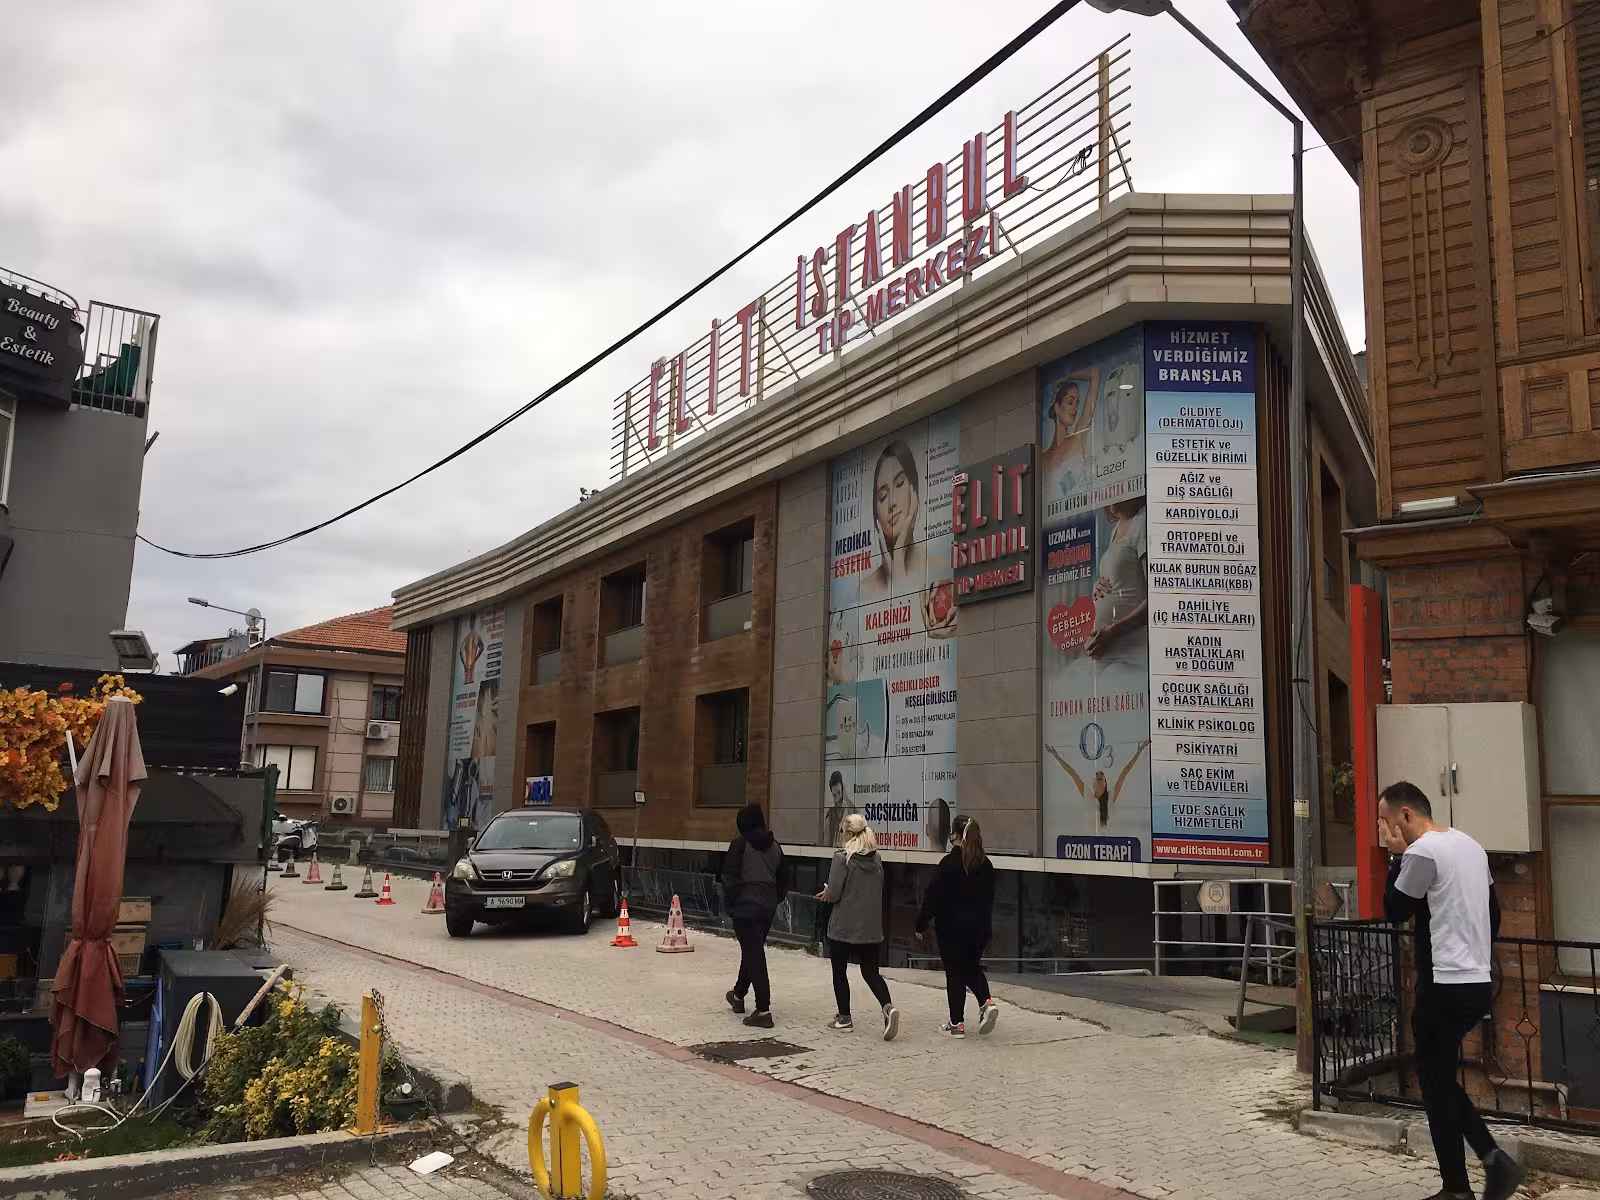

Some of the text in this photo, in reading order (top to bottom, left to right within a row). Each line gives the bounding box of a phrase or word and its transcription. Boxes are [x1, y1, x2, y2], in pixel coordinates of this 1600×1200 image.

[866, 212, 1000, 330] MERKEZİ
[648, 110, 1029, 451] ELİT İSTANBUL
[7, 297, 60, 330] Beauty
[24, 325, 38, 342] &
[1170, 327, 1229, 344] HİZMET
[0, 336, 55, 366] Estetik
[1153, 347, 1248, 363] VERDİĞİMİZ
[1159, 368, 1242, 385] BRANŞLAR
[1180, 405, 1222, 418] CİLDİYE
[1158, 417, 1244, 430] (DERMATOLOJİ)
[1171, 437, 1231, 450] ESTETİK ve
[1156, 450, 1247, 464] GÜZELLİK BİRİMİ
[1096, 457, 1127, 478] Lazer
[1180, 471, 1221, 484] AĞIZ ve
[1167, 484, 1233, 500] DİŞ SAĞLIĞI
[1165, 505, 1239, 520] KARDİYOLOJİ
[835, 529, 872, 557] MEDİKAL
[1048, 527, 1077, 546] UZMAN
[1167, 528, 1238, 543] ORTOPEDİ ve
[1160, 540, 1245, 554] TRAVMATOLOJİ
[834, 549, 872, 579] ESTETİK
[1047, 543, 1091, 570] DOĞUM
[1048, 565, 1091, 586] EKİBİMİZ İLE
[1149, 561, 1257, 576] KULAK BURUN BOĞAZ
[1153, 577, 1253, 590] HASTALIKLARI(KBB)
[1178, 599, 1230, 613] DAHİLİYE
[865, 600, 911, 631] KALBİNİZİ
[1052, 611, 1091, 634] GEBELİK
[1153, 610, 1255, 627] (İÇ HASTALIKLARI)
[1061, 636, 1085, 650] DOĞUM
[1187, 636, 1222, 648] KADIN
[1165, 647, 1245, 660] HASTALIKLARI
[1176, 658, 1234, 672] ve DOĞUM
[891, 674, 940, 694] SAĞLIKLI DİŞLER
[1162, 681, 1249, 697] ÇOCUK SAĞLIĞI
[1157, 696, 1254, 709] ve HASTALIKLARI
[1157, 717, 1255, 732] KLİNİK PSİKOLOG
[1176, 742, 1238, 756] PSİKİYATRİ
[1180, 766, 1234, 782] SAÇ EKİM
[1167, 779, 1248, 793] ve TEDAVİLERİ
[865, 799, 919, 825] SAÇSIZLIĞA
[1171, 802, 1246, 817] EVDE SAĞLIK
[1174, 816, 1243, 830] HİZMETLERİ
[1064, 840, 1132, 861] OZON TERAPİ
[1156, 844, 1263, 858] www.elitistanbul.com.tr
